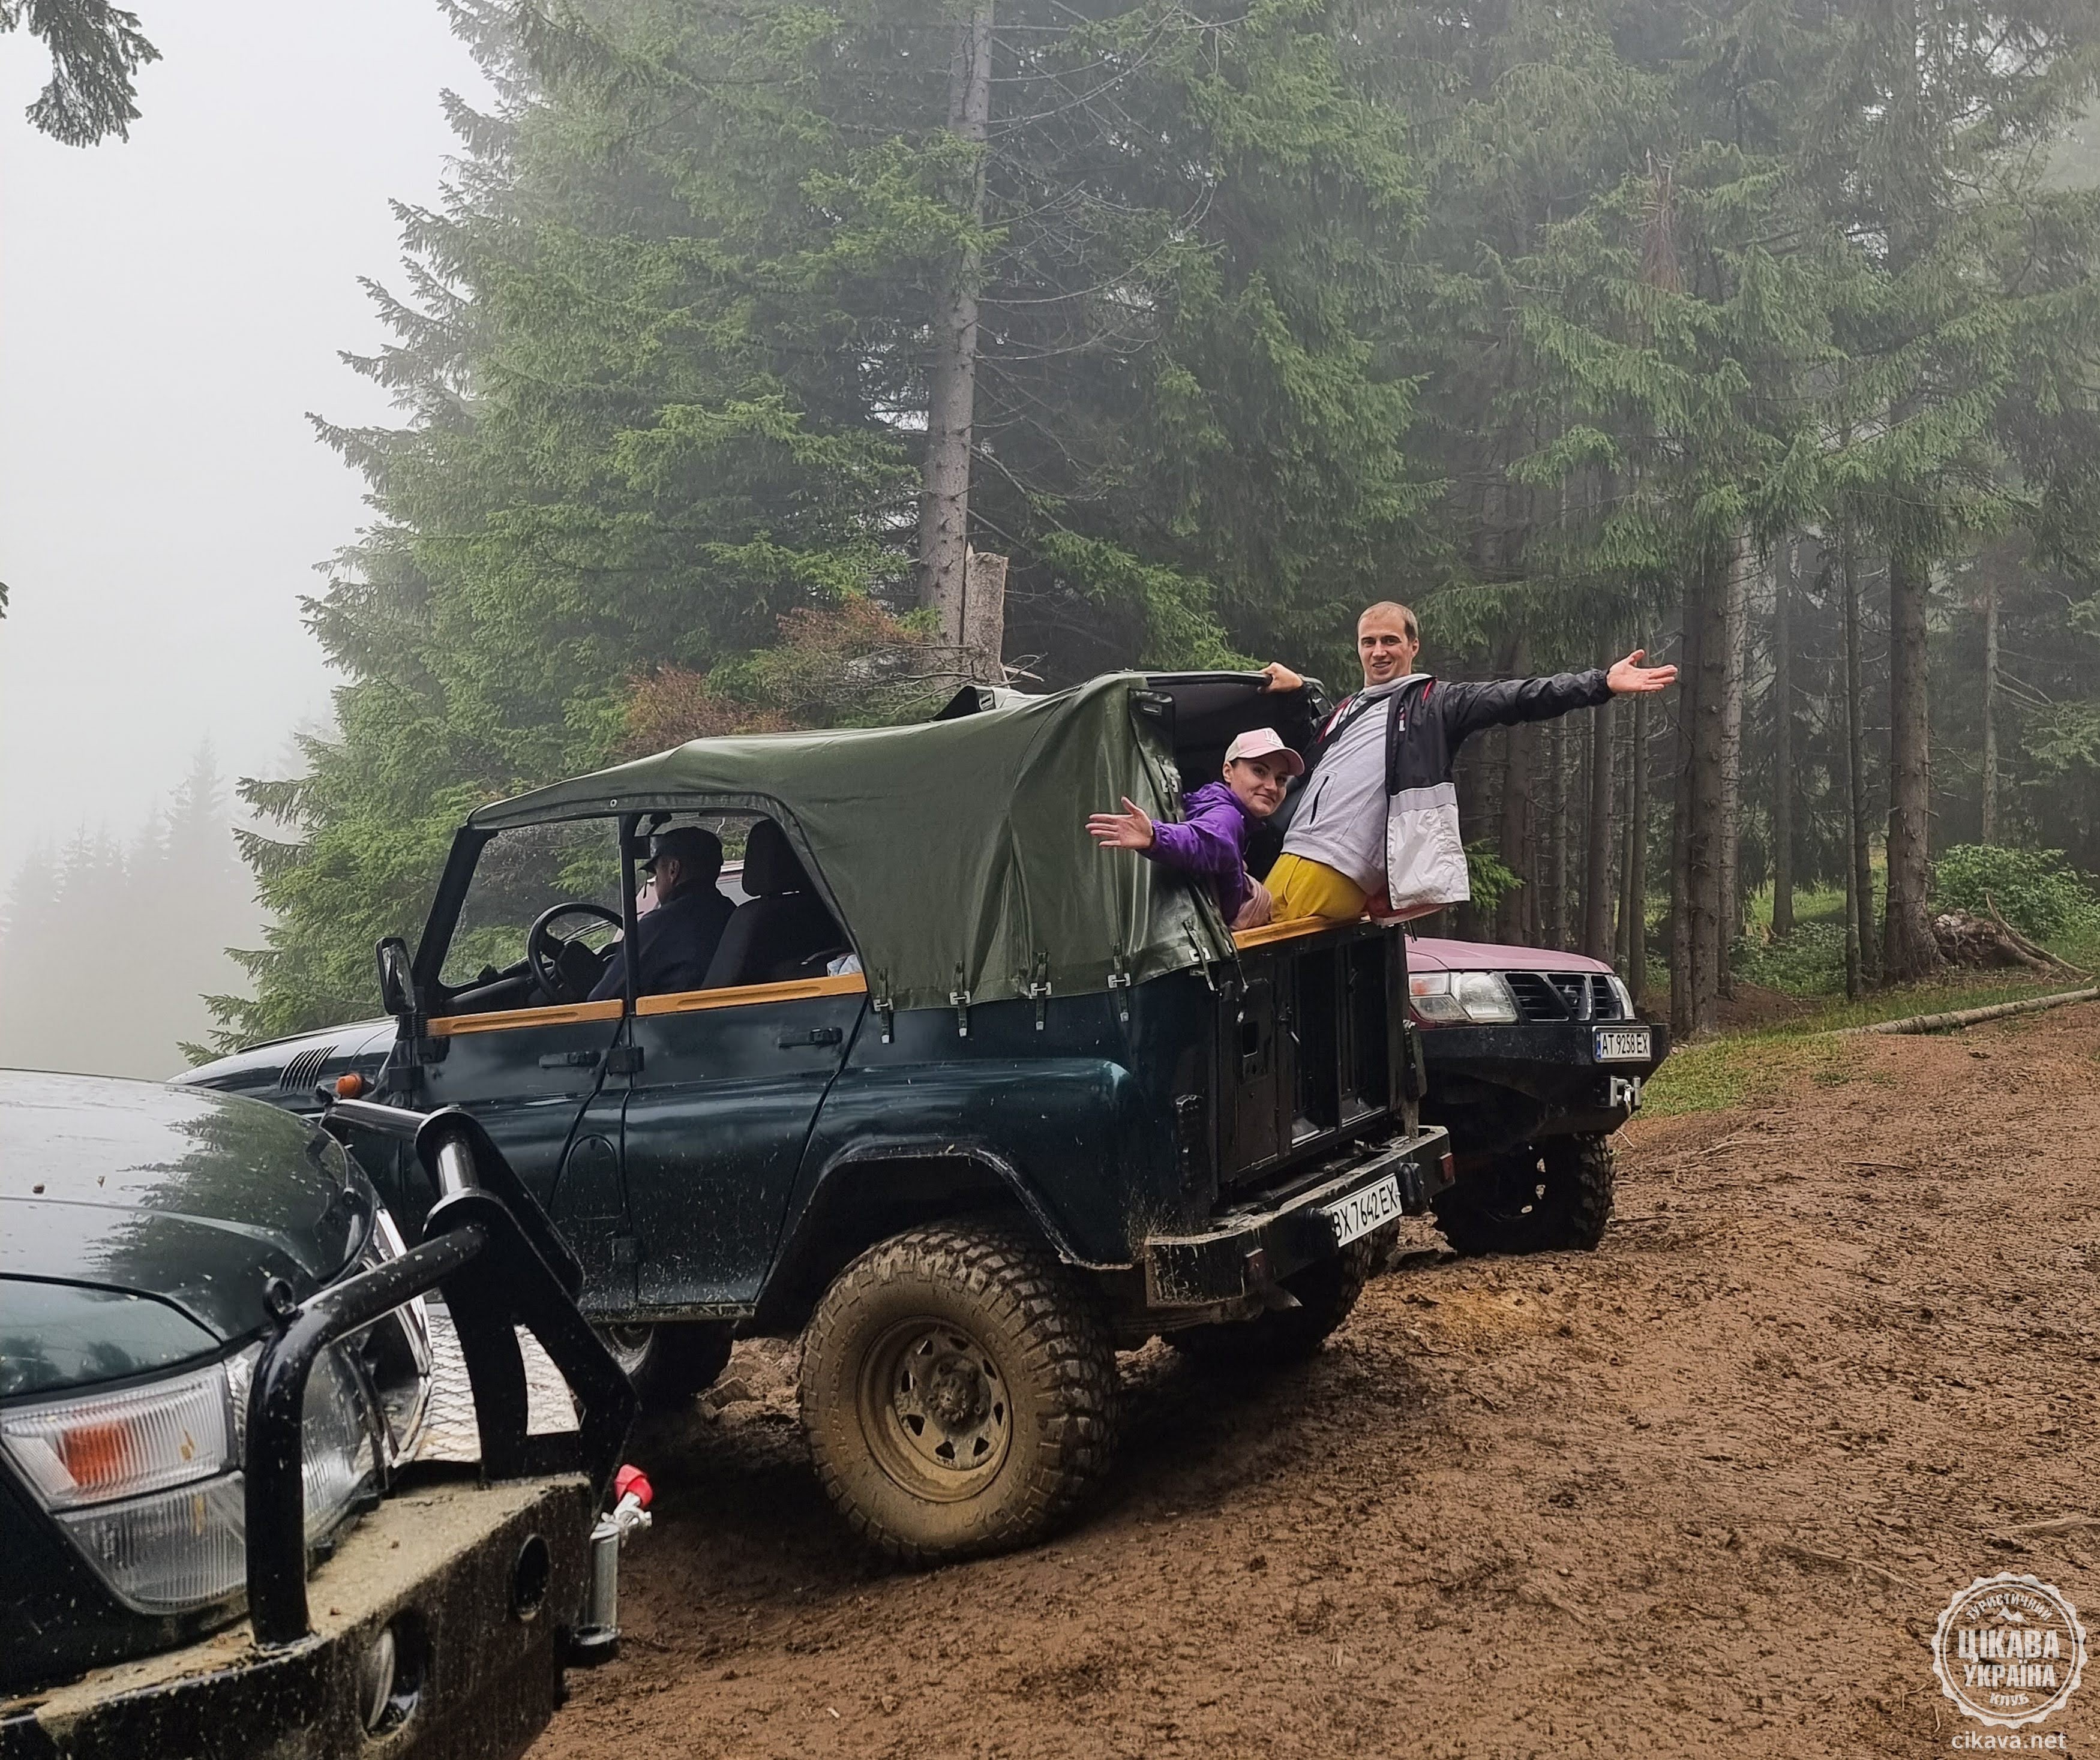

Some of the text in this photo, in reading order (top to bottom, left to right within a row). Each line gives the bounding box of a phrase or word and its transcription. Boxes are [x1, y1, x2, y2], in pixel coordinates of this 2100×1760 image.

[1602, 1034, 1648, 1055] AT 9258 EX
[1333, 1182, 1397, 1241] BX 7642 EX
